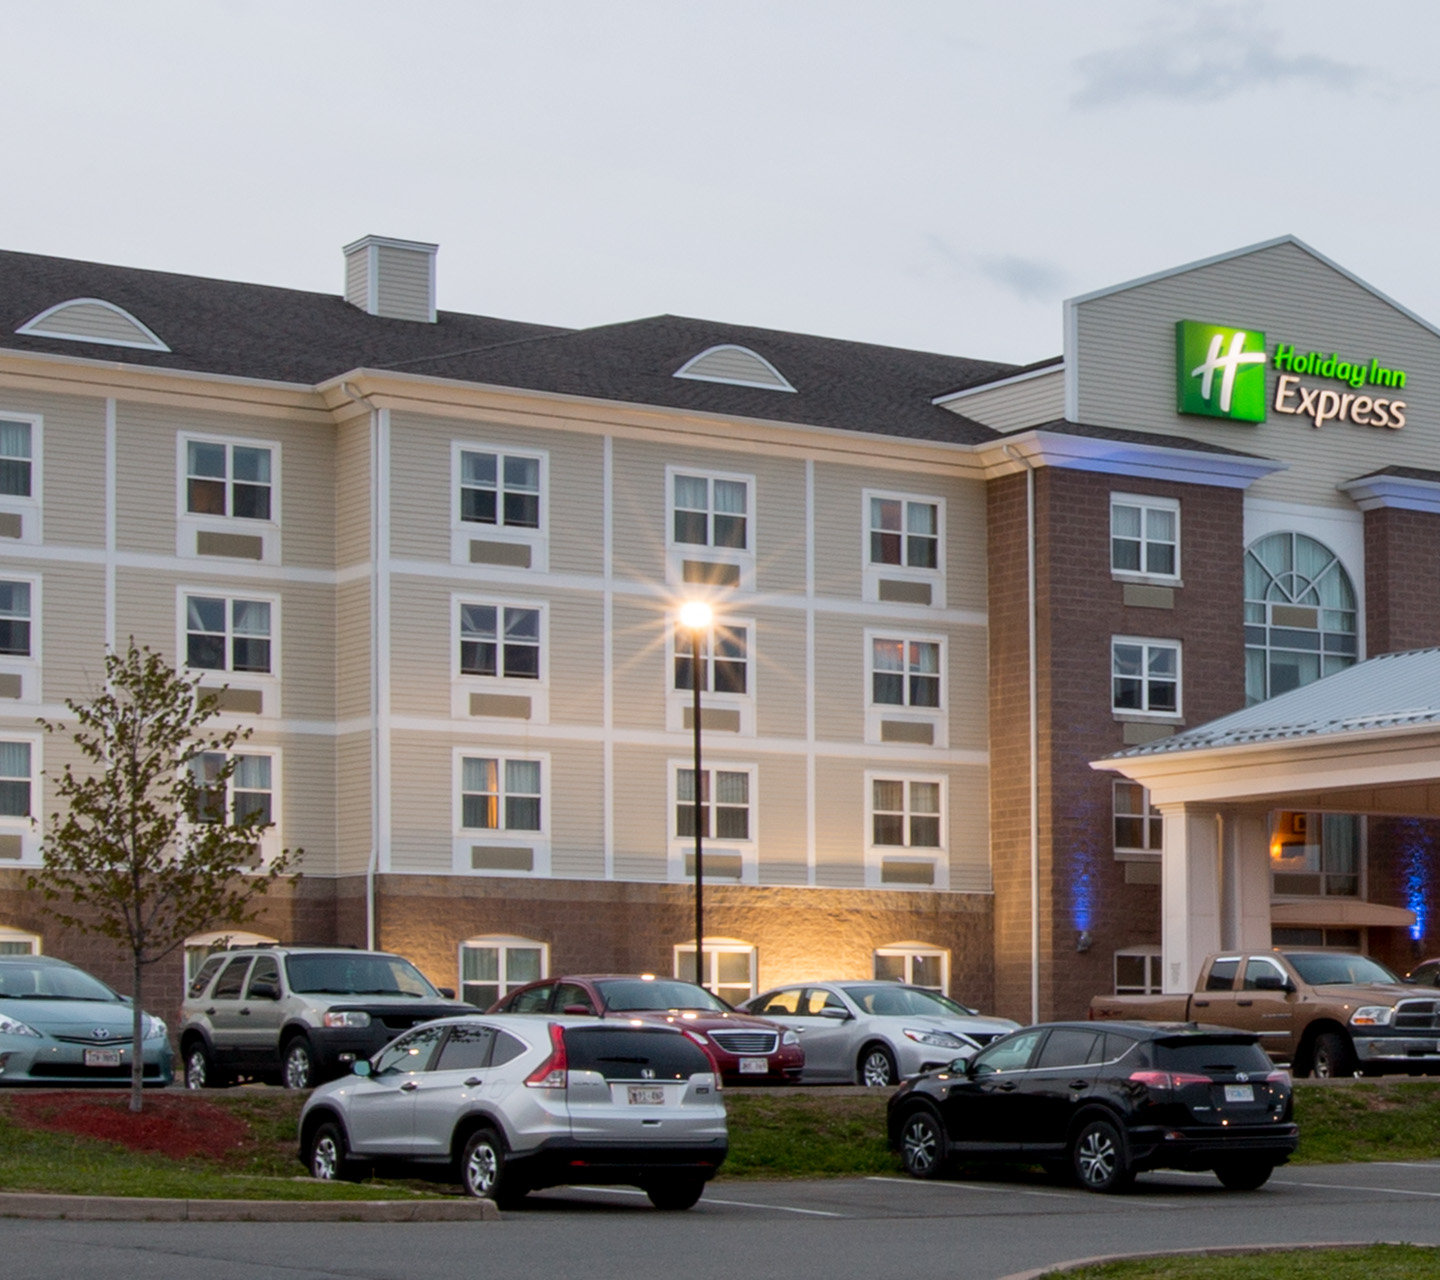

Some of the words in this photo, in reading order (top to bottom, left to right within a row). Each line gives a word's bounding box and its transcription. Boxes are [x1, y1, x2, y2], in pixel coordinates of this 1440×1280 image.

[1273, 343, 1365, 387] Holiday
[1369, 358, 1406, 388] Inn
[1273, 374, 1408, 429] Express
